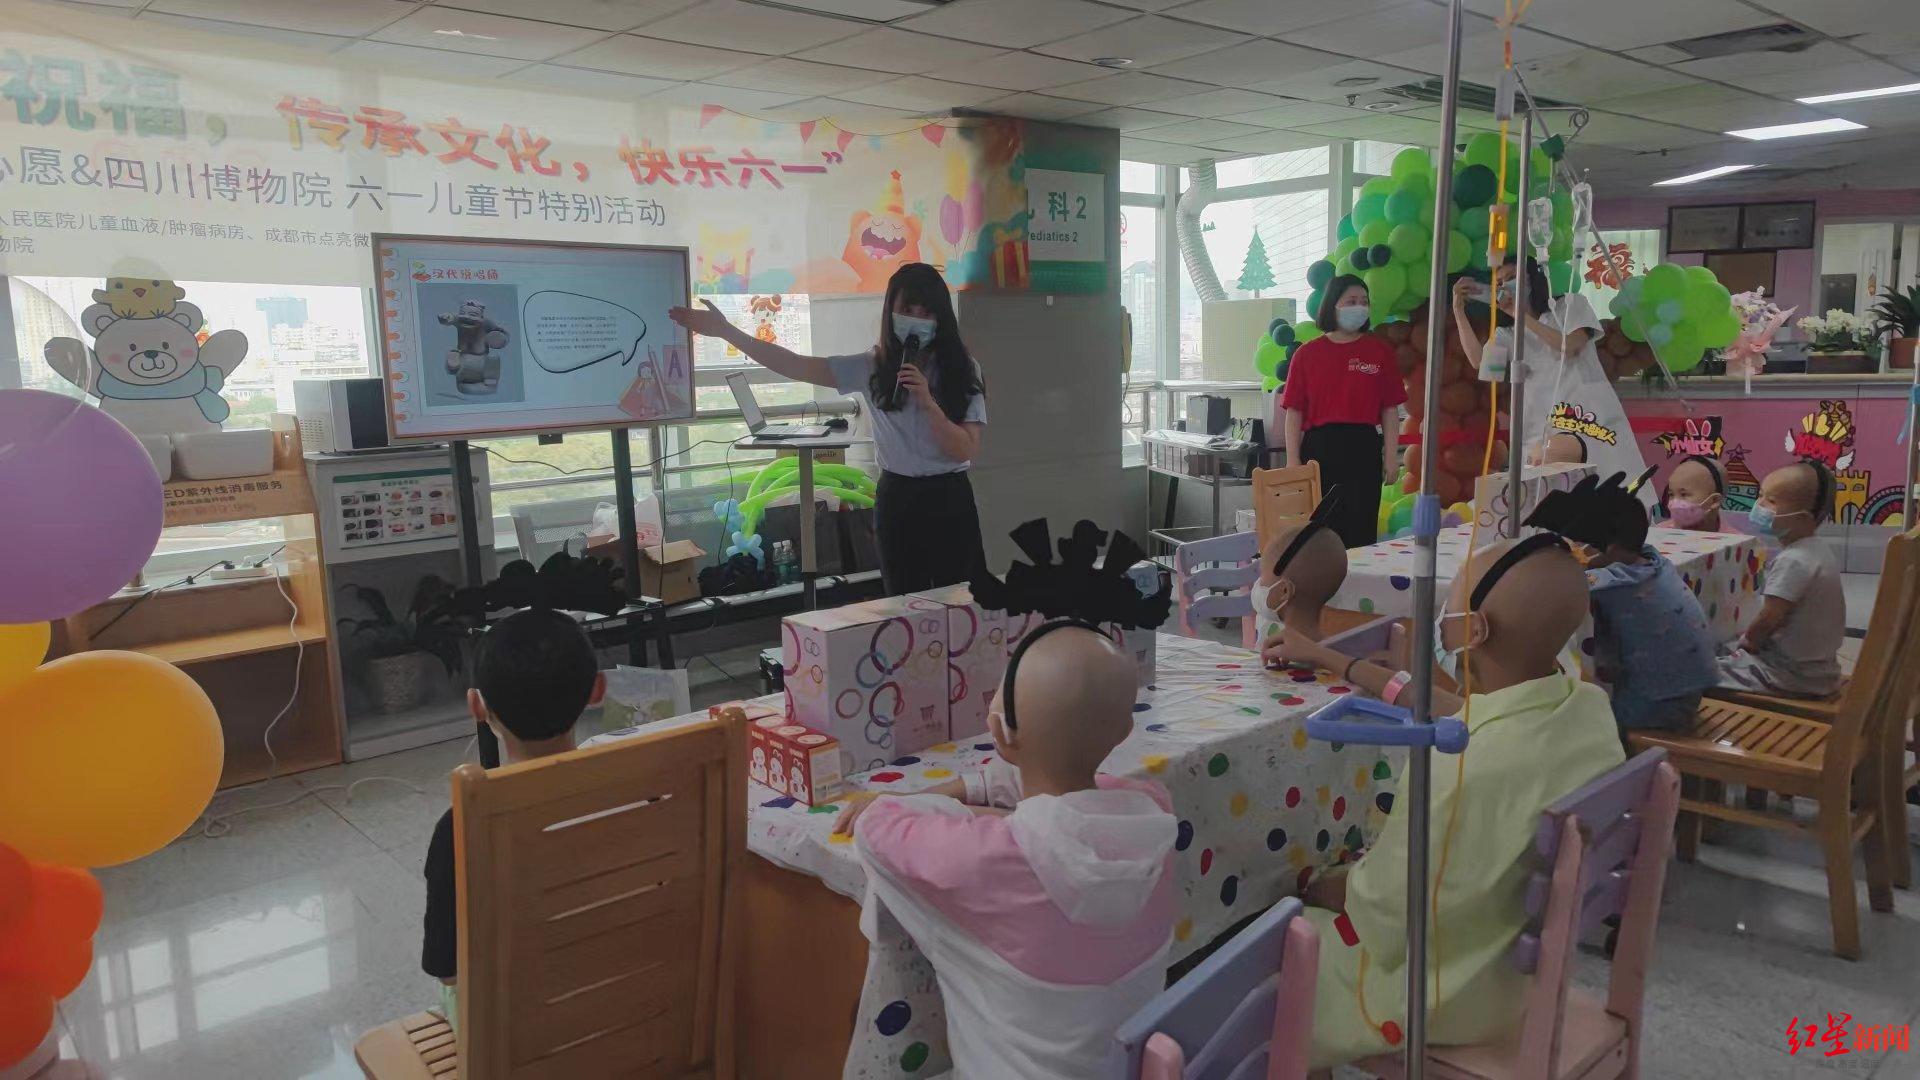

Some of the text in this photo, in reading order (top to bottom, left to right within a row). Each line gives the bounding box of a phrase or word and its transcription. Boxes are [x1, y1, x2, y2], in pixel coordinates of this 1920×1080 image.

[345, 175, 667, 228] 六一儿童节特别活动
[1028, 191, 1086, 222] 科2
[1027, 230, 1078, 242] ediatics 2
